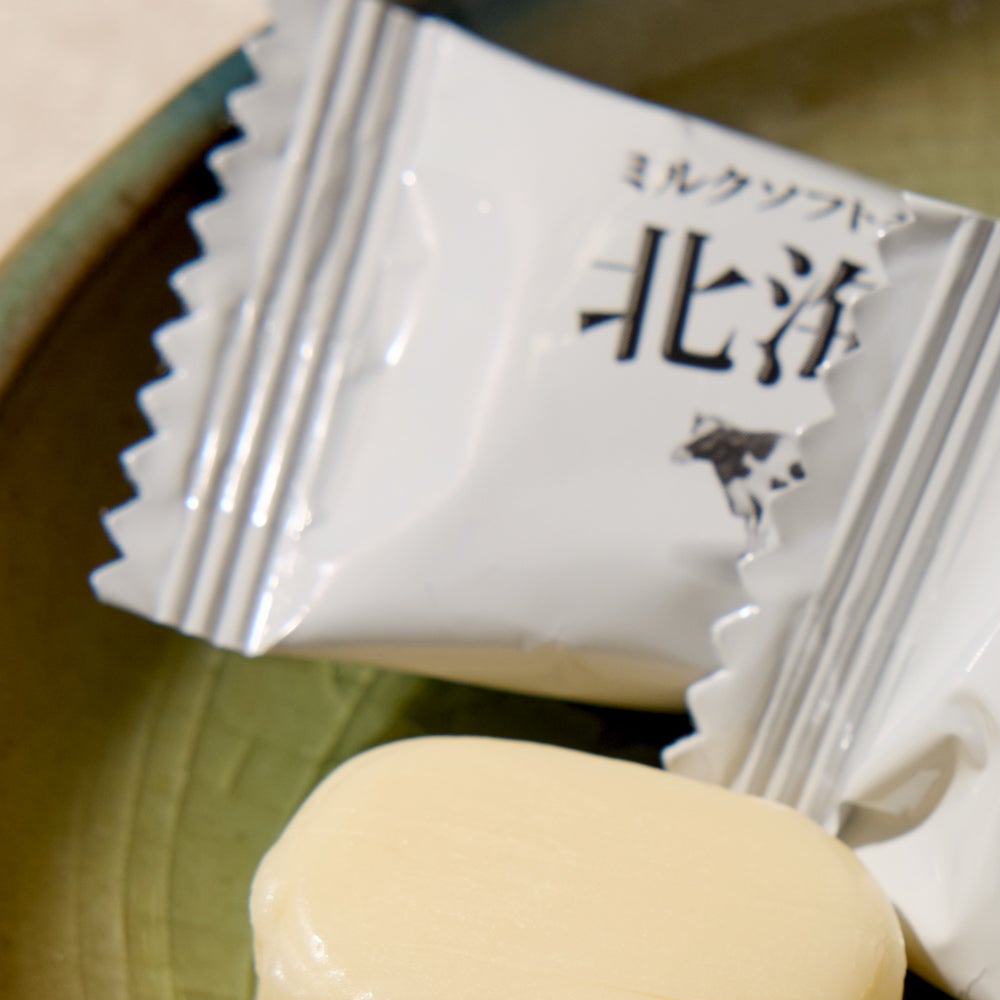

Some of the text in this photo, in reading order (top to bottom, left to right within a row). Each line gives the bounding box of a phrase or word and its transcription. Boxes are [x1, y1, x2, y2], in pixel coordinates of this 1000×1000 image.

[622, 151, 908, 232] ミルクソフト
